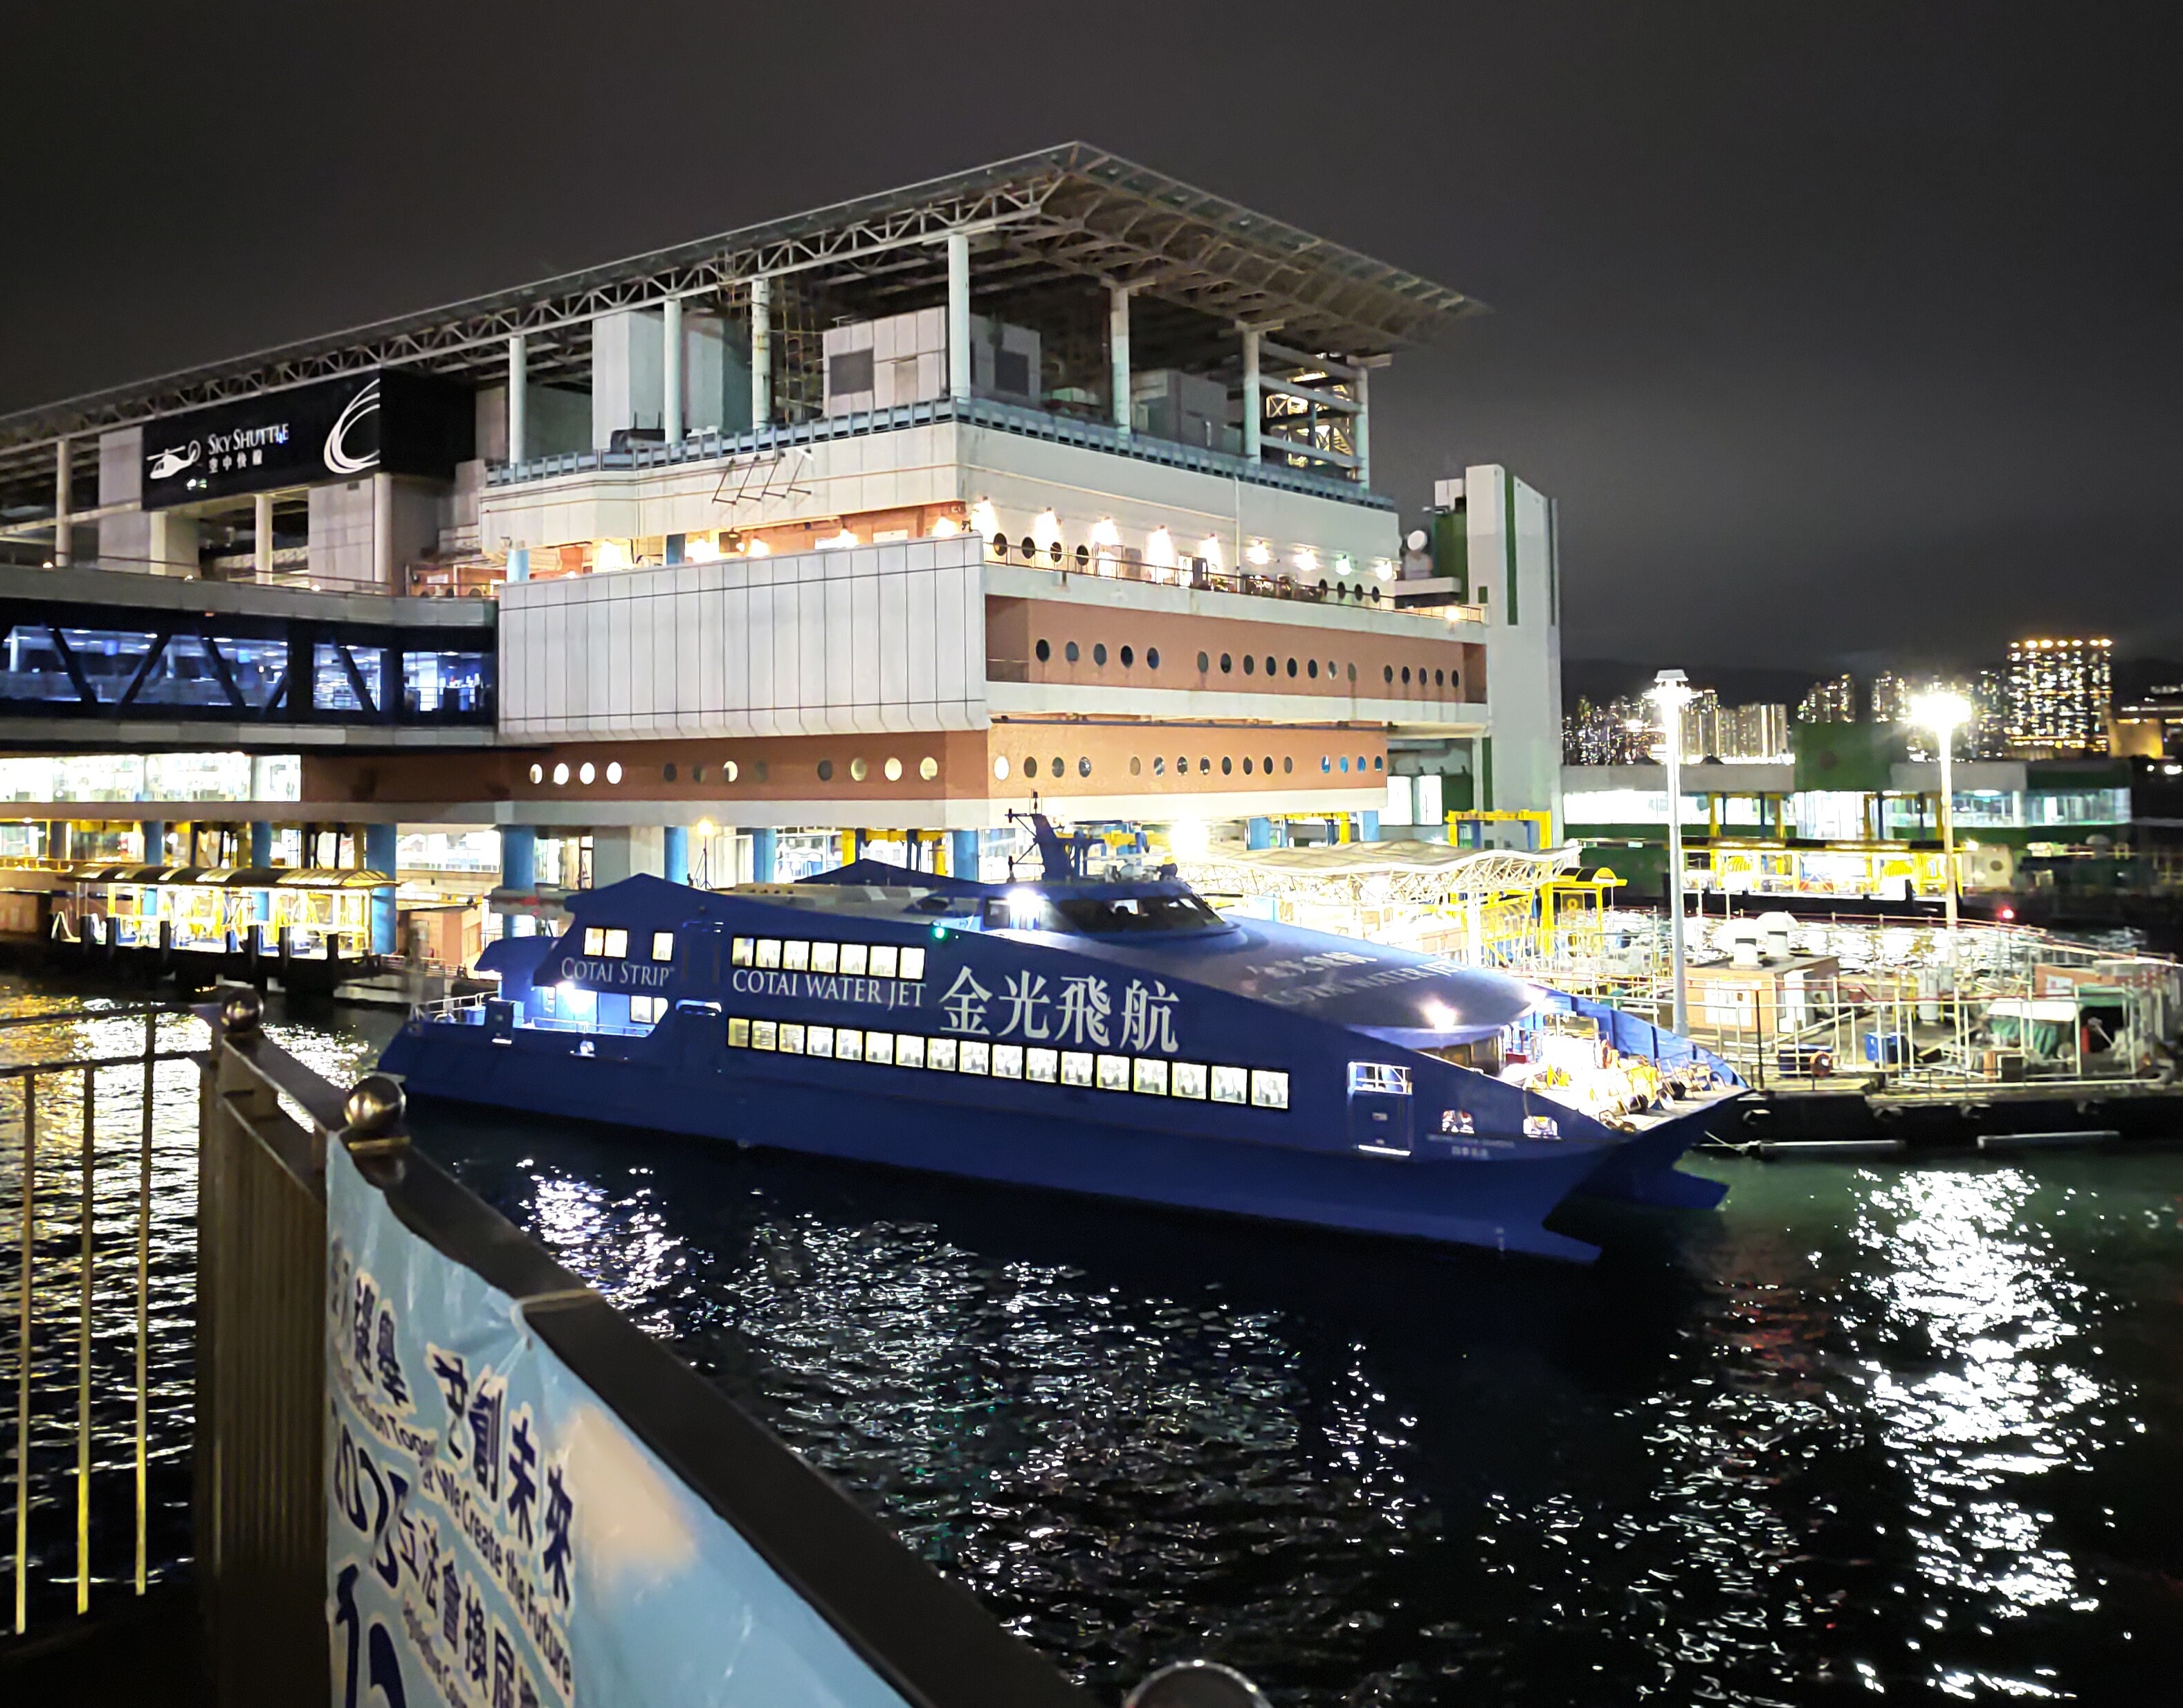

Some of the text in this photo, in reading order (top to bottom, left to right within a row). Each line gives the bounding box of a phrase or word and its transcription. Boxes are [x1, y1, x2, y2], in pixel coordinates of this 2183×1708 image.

[561, 957, 670, 987] COTAI STRIP
[732, 968, 927, 1012] COTAI WATER JET
[938, 964, 1180, 1054] 金光飛航
[462, 1489, 502, 1579] Create
[527, 1581, 572, 1696] Future
